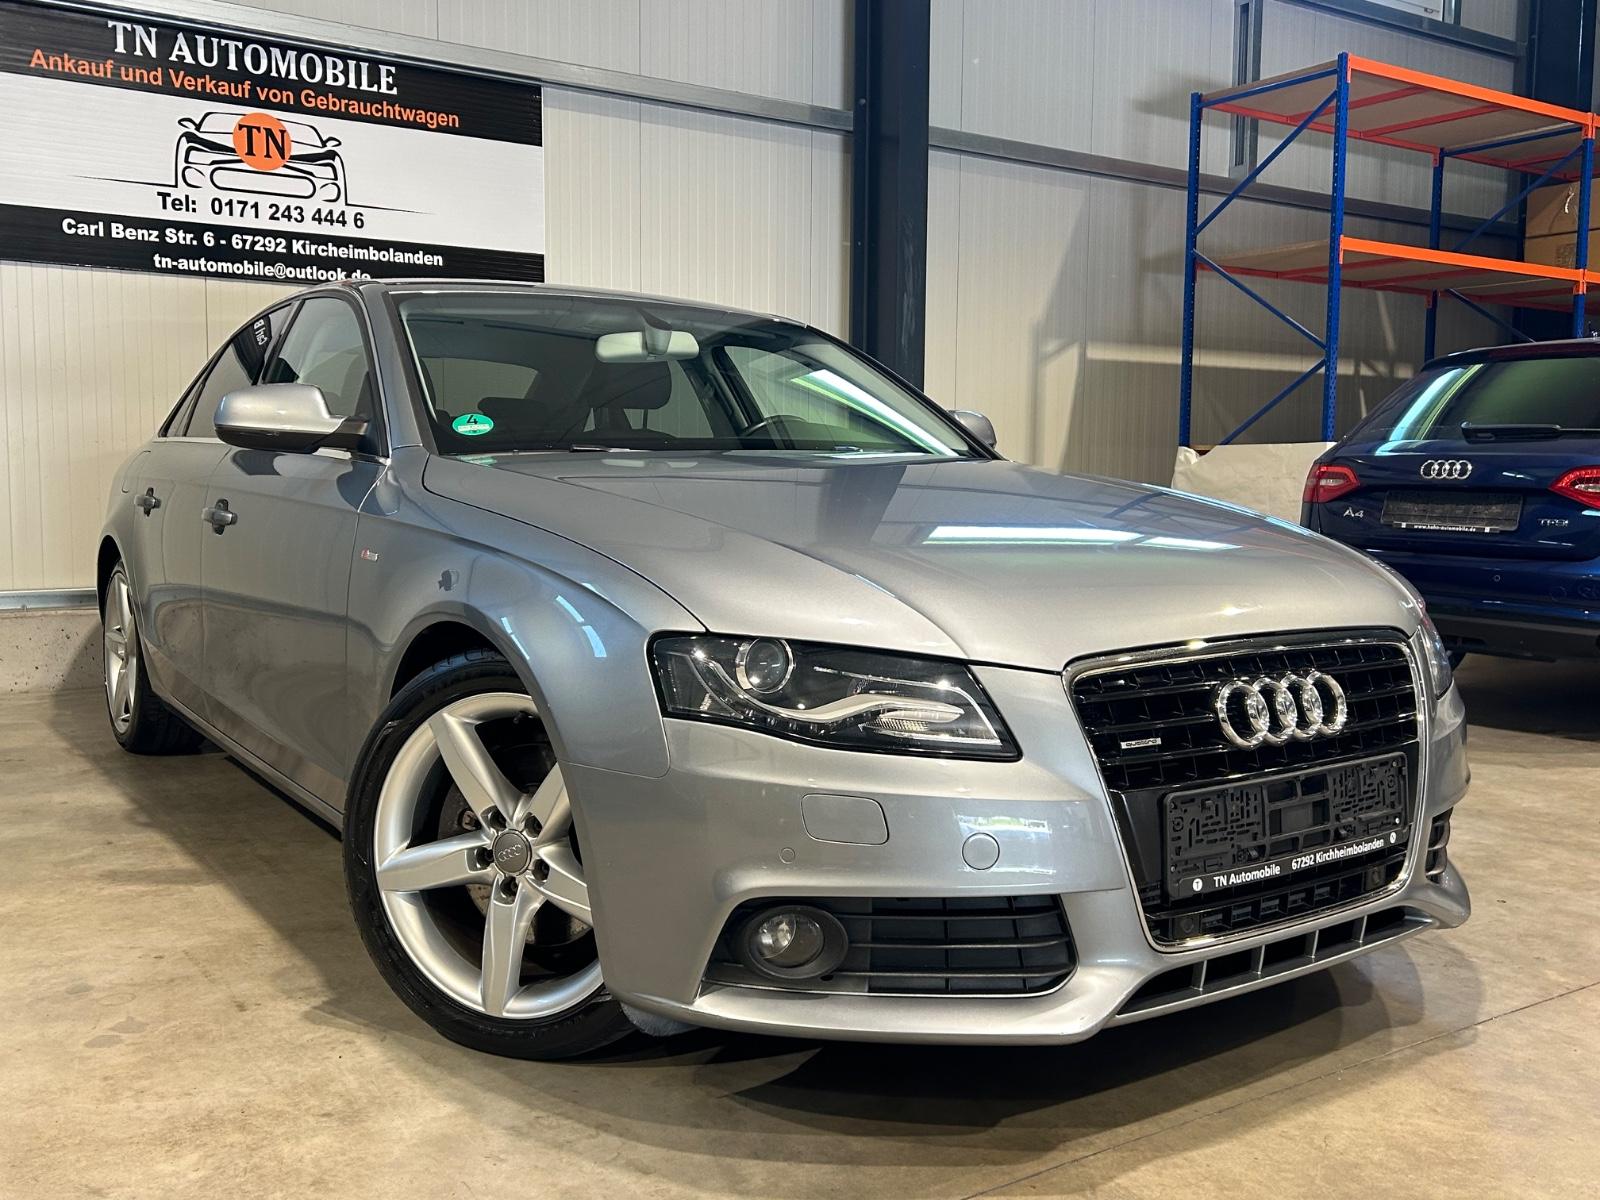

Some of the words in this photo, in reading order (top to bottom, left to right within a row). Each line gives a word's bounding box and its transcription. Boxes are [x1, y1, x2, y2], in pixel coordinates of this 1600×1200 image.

[107, 20, 157, 59] TN
[169, 32, 398, 95] AUTOMOBILE
[29, 48, 114, 79] Ankauf
[120, 67, 163, 86] und
[169, 68, 252, 99] Verkauf
[257, 85, 294, 104] von
[300, 89, 460, 129] Gebrauchtwagen
[238, 123, 287, 160] TN
[157, 191, 197, 213] Tel:
[211, 197, 260, 219] 0171
[268, 203, 305, 223] 243
[311, 208, 347, 228] 444
[353, 212, 365, 229] 6
[61, 218, 104, 237] Carl
[111, 222, 159, 243] Benz
[165, 228, 198, 246] Str.
[203, 231, 215, 247] 6
[231, 234, 287, 254] 67292
[291, 239, 443, 267] Kircheimbolanden
[153, 253, 371, 280] tn-automobile@outlookde
[466, 414, 479, 425] 4
[1343, 506, 1364, 518] A4
[1213, 875, 1227, 888] TN
[1229, 863, 1281, 885] Automobile
[1291, 855, 1315, 870] 67292
[1315, 838, 1385, 864] Kirchheimbolanden
